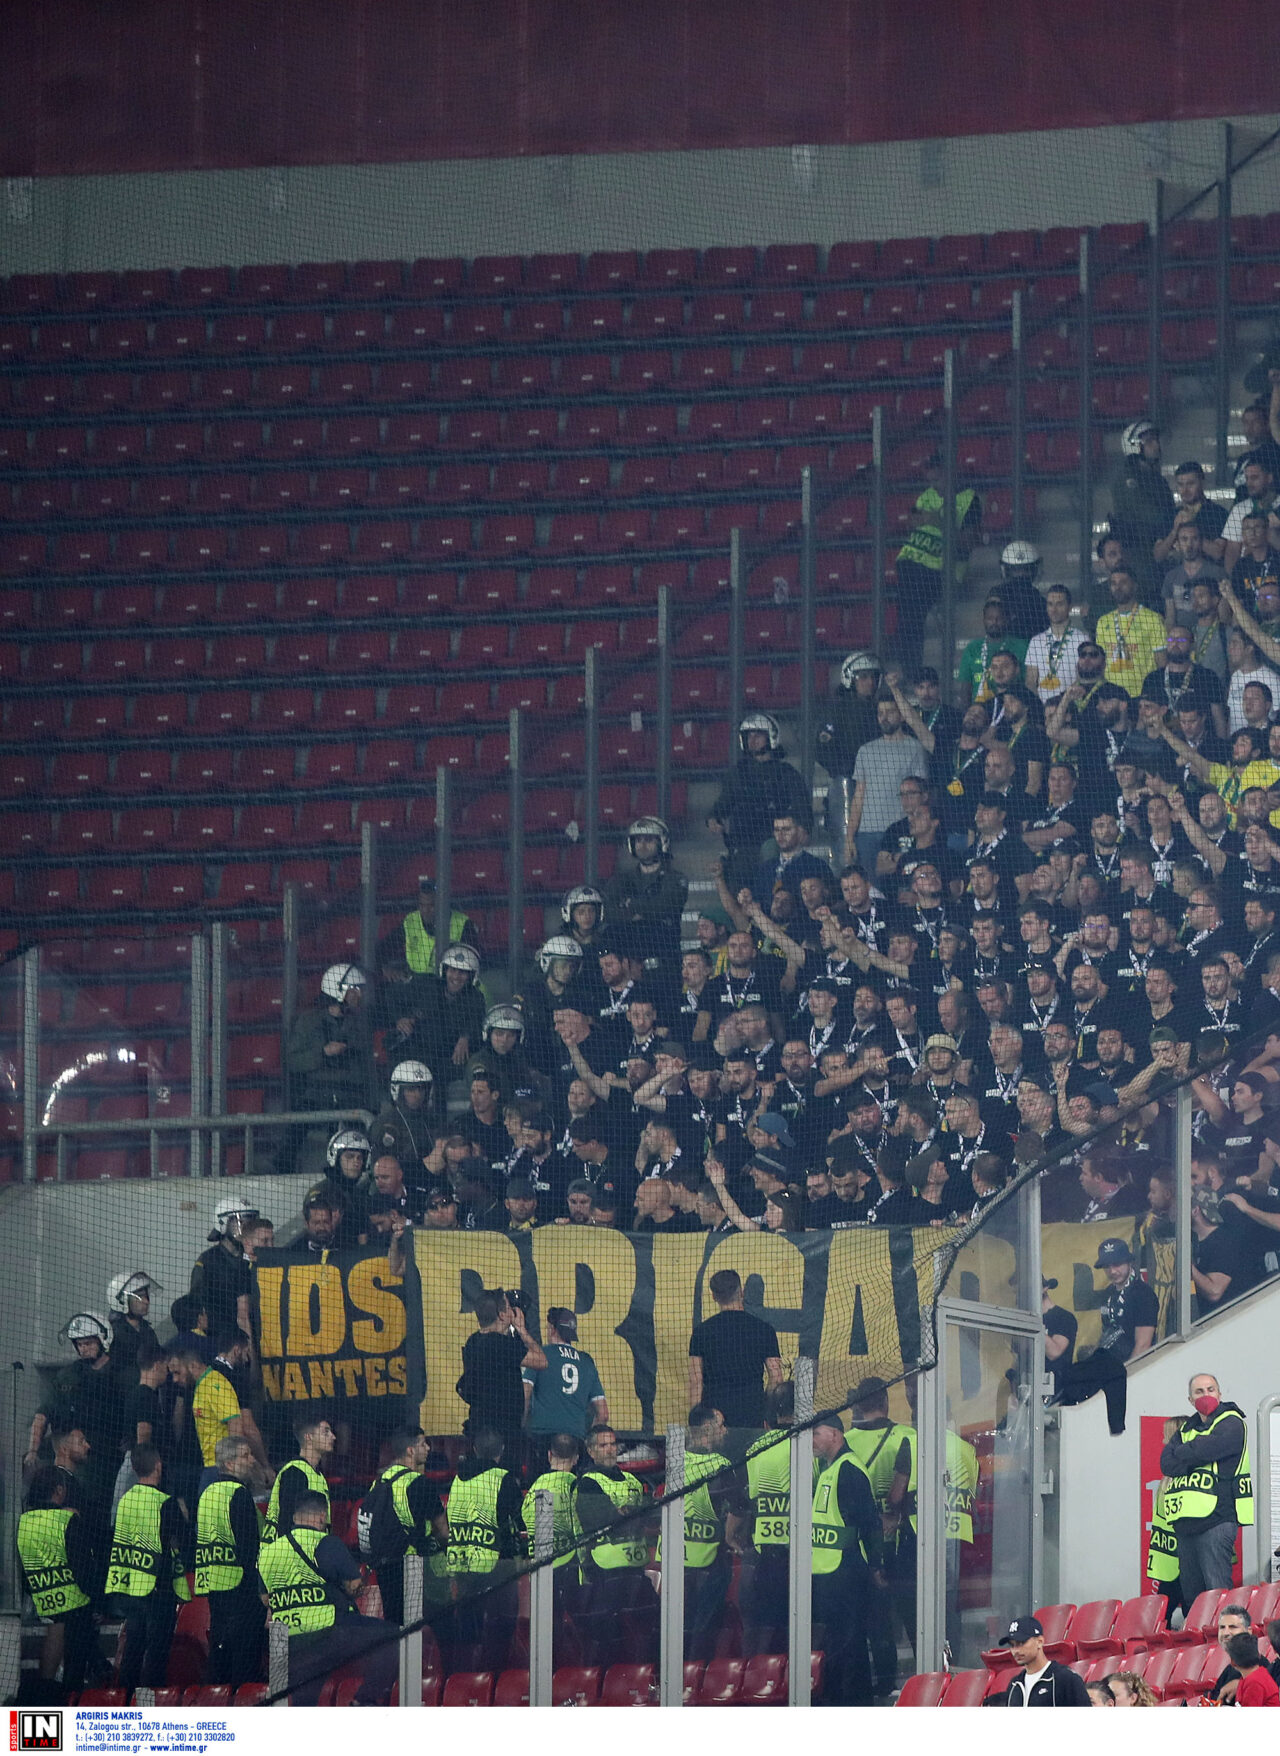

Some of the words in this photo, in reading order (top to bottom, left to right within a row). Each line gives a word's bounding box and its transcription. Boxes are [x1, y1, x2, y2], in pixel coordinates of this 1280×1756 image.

[257, 1256, 407, 1358] IDS
[558, 1346, 580, 1361] SALA
[261, 1356, 408, 1402] NANTES
[561, 1363, 579, 1395] 9
[1165, 1496, 1184, 1516] 335
[38, 1591, 66, 1611] 289
